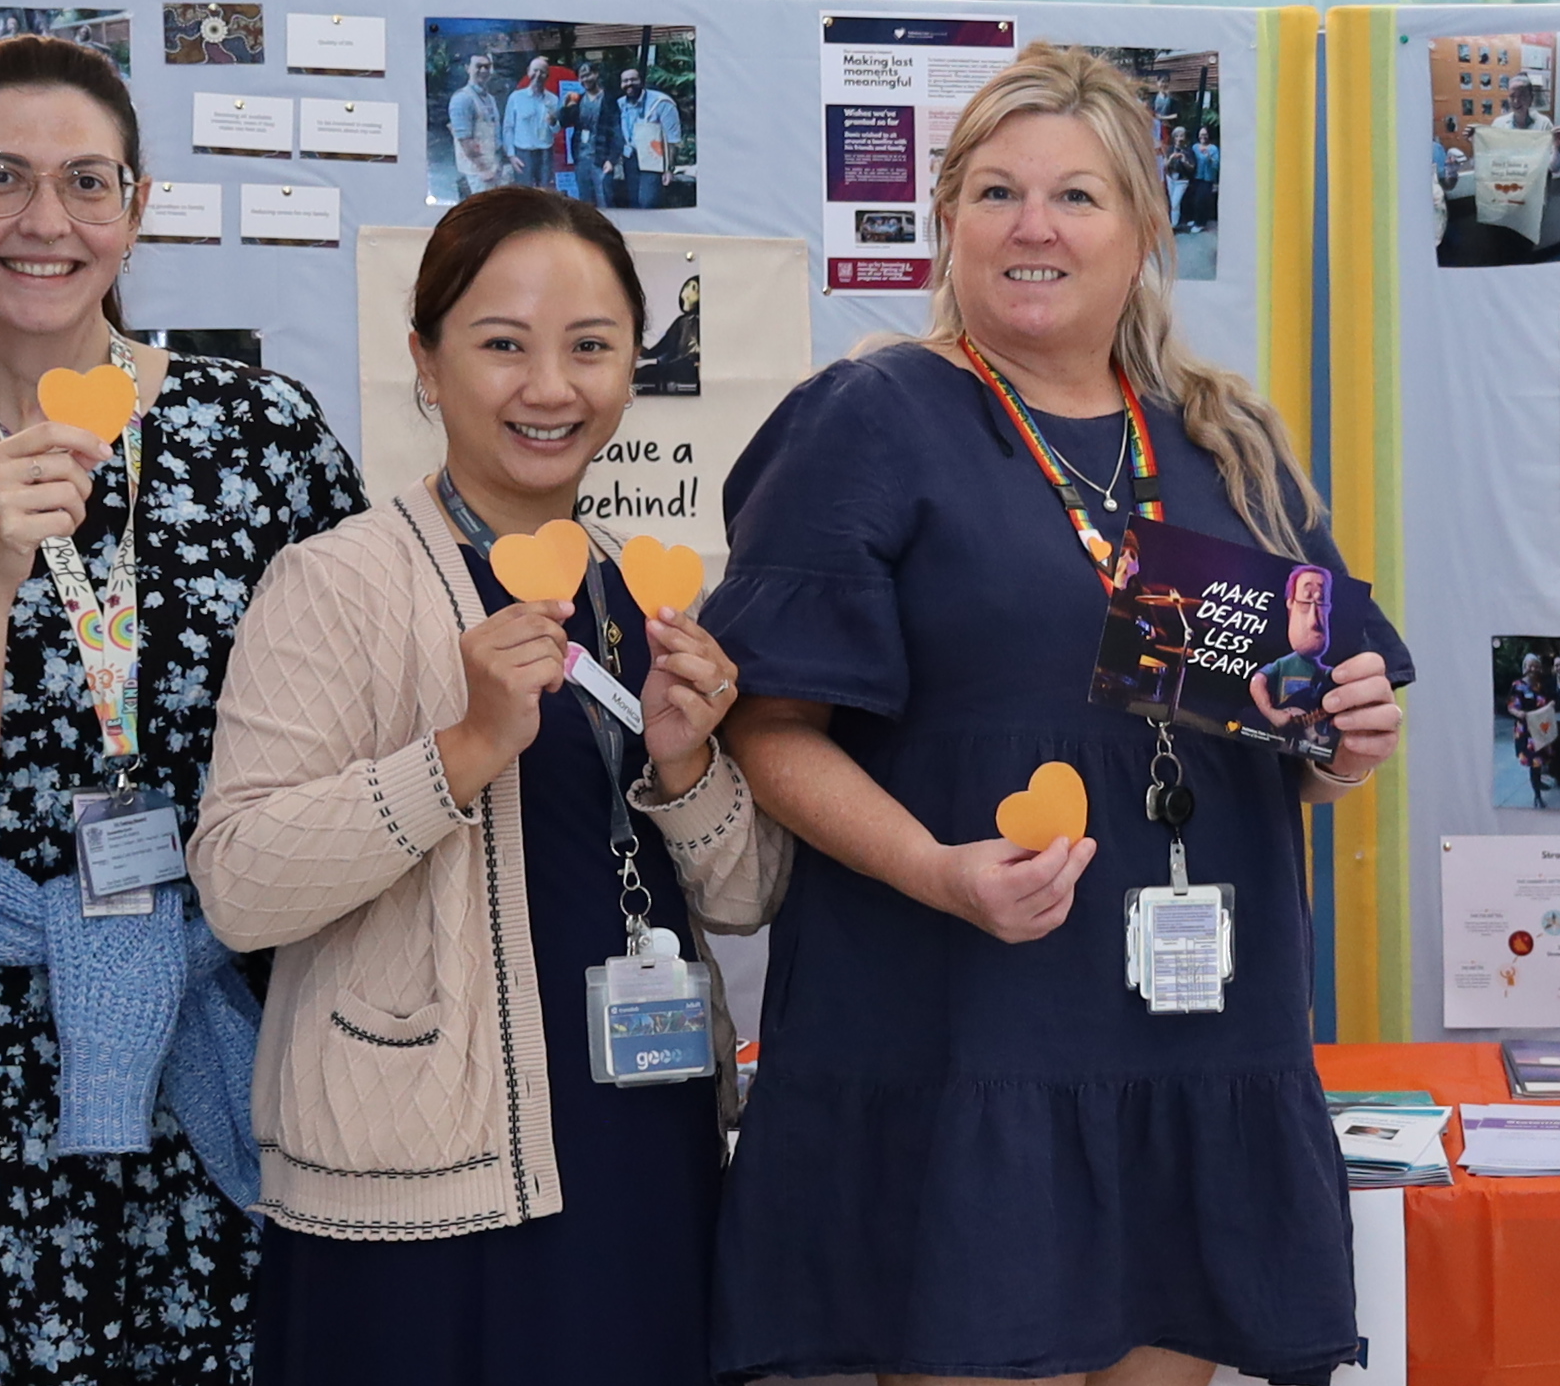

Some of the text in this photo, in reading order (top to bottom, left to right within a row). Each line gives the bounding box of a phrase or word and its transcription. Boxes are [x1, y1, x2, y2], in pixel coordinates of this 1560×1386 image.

[843, 55, 914, 69] Making last
[843, 67, 899, 77] moments
[843, 76, 912, 89] meaningful
[592, 440, 693, 464] ave a
[1201, 580, 1275, 612] MAKE
[1196, 600, 1269, 635] DEATH
[1203, 627, 1253, 654] LESS
[1187, 647, 1258, 680] SCARY
[611, 692, 641, 724] Monica
